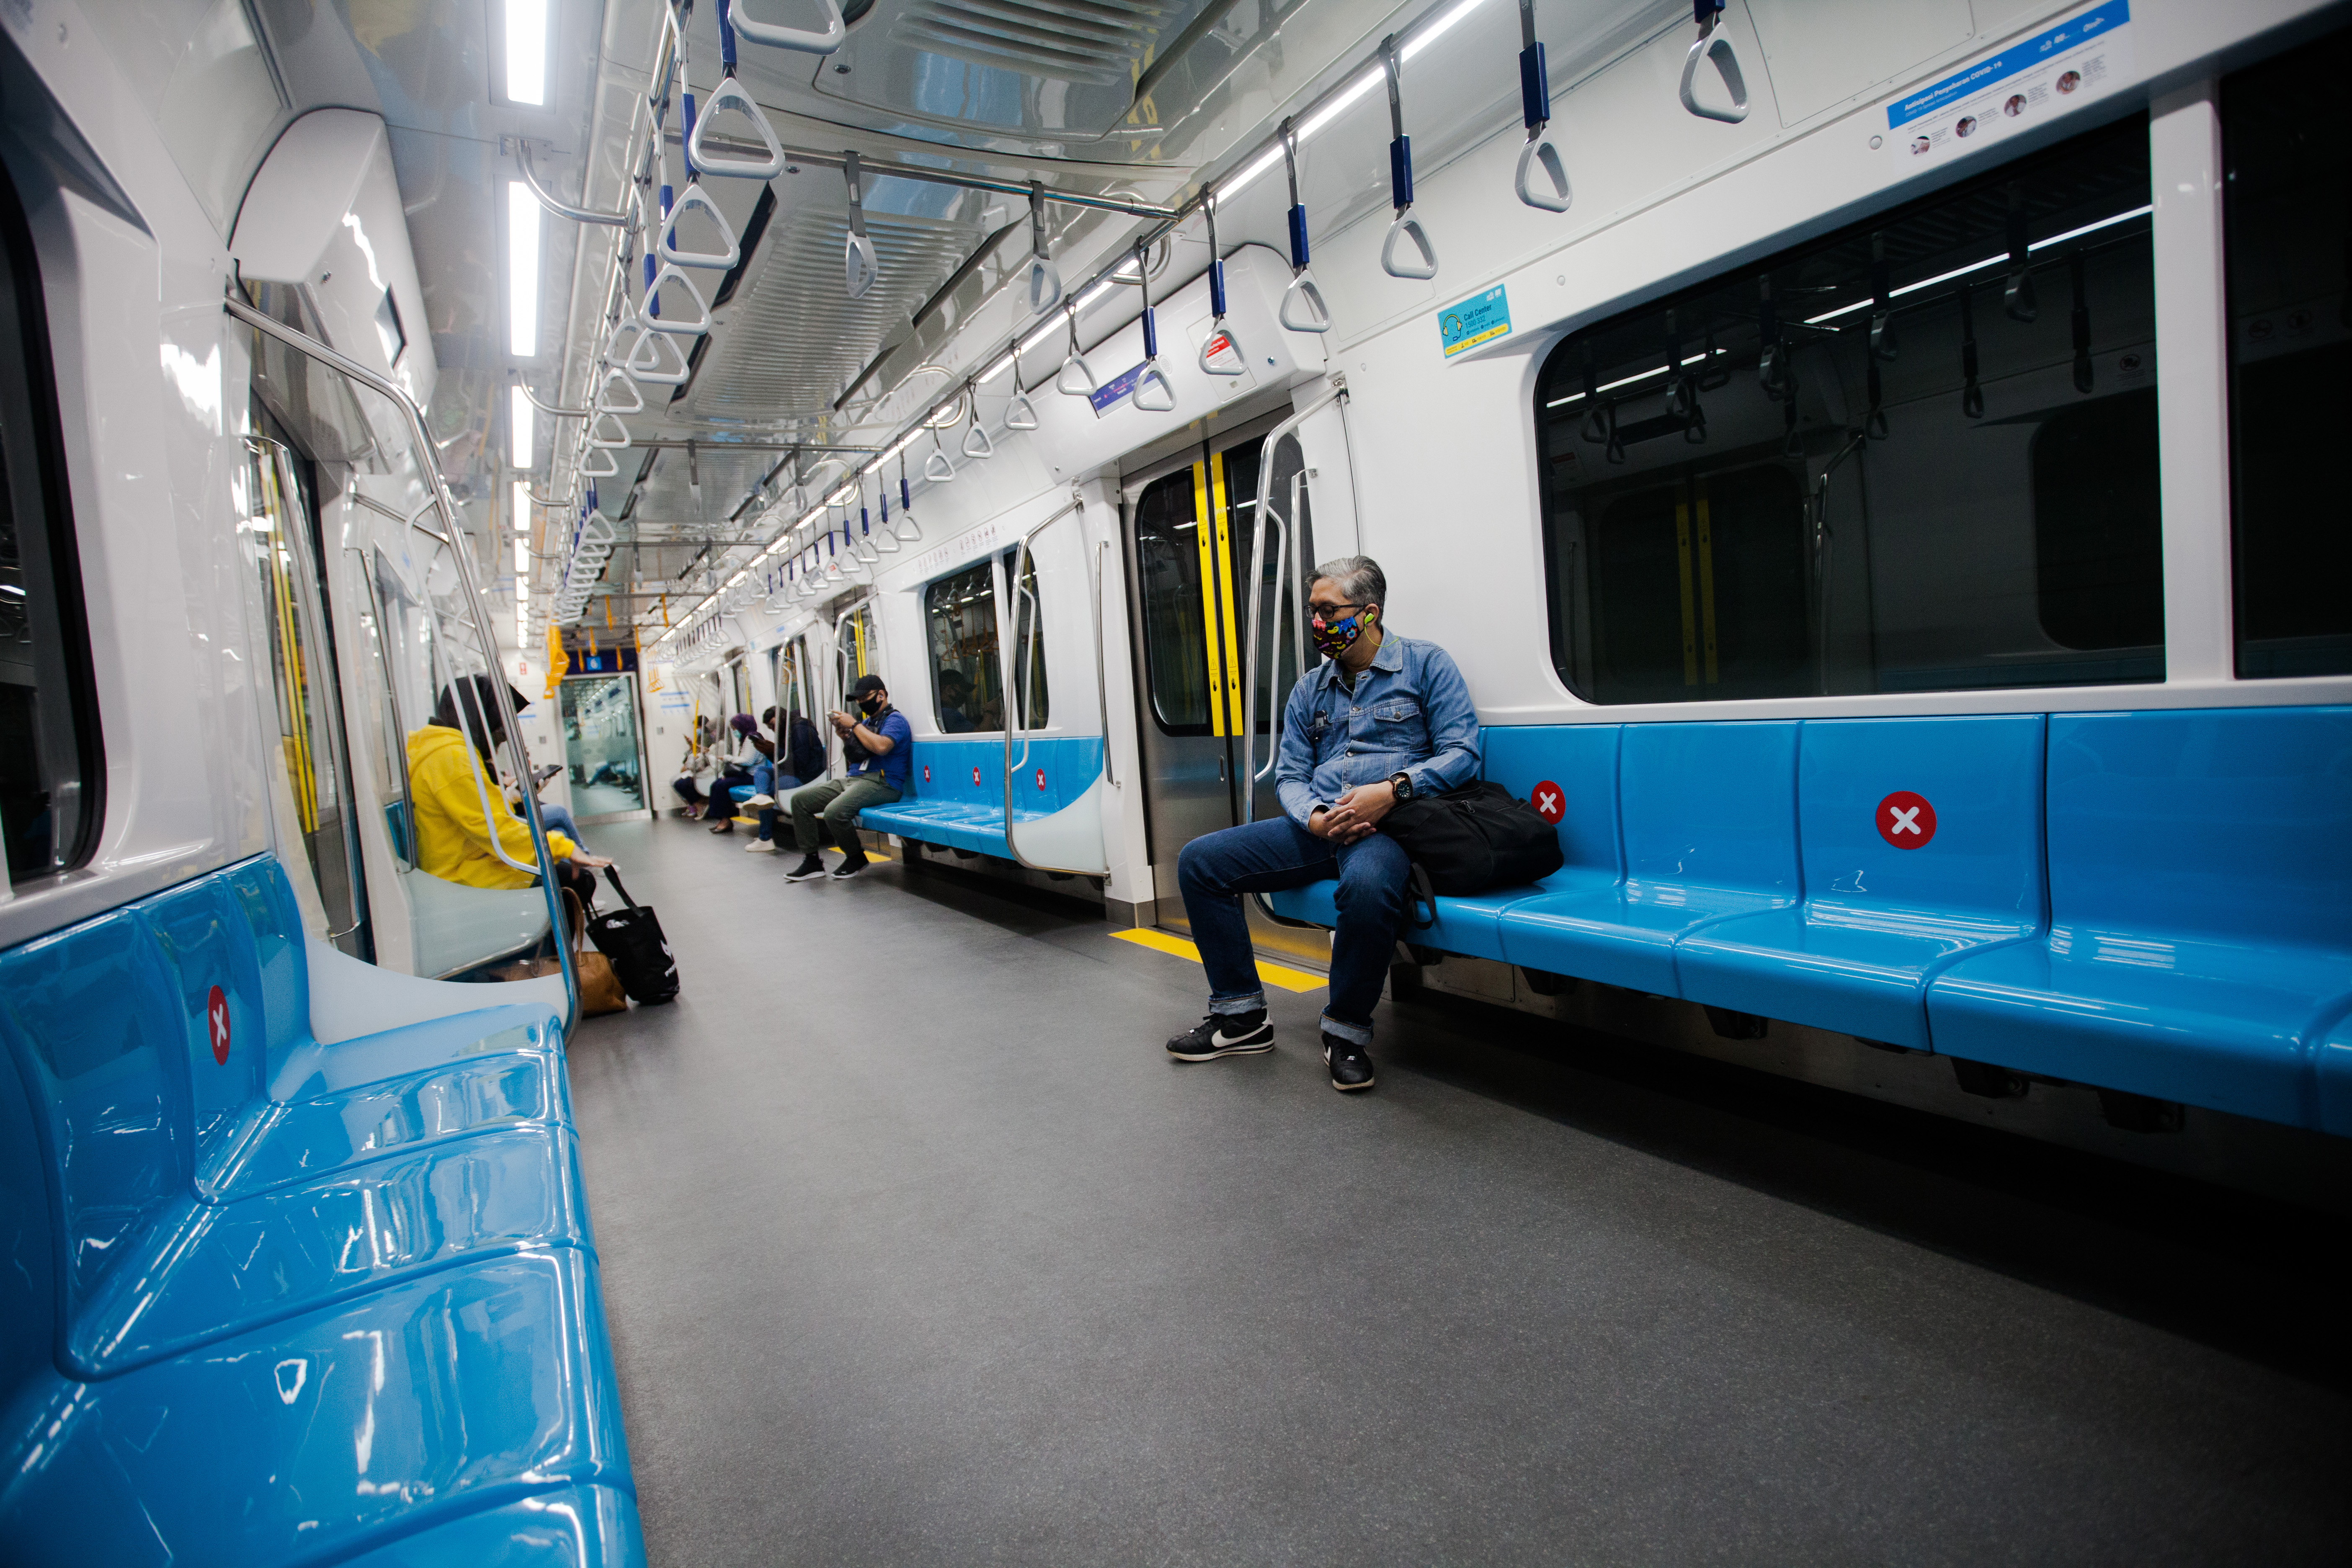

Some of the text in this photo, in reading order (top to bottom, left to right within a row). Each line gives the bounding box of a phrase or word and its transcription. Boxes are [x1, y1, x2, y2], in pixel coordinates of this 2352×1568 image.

[1905, 93, 1934, 111] Antisipasi
[1934, 77, 1970, 97] Penyebaran
[1464, 305, 1491, 320] Call Center
[1465, 319, 1476, 329] 1500
[1477, 315, 1485, 324] 332
